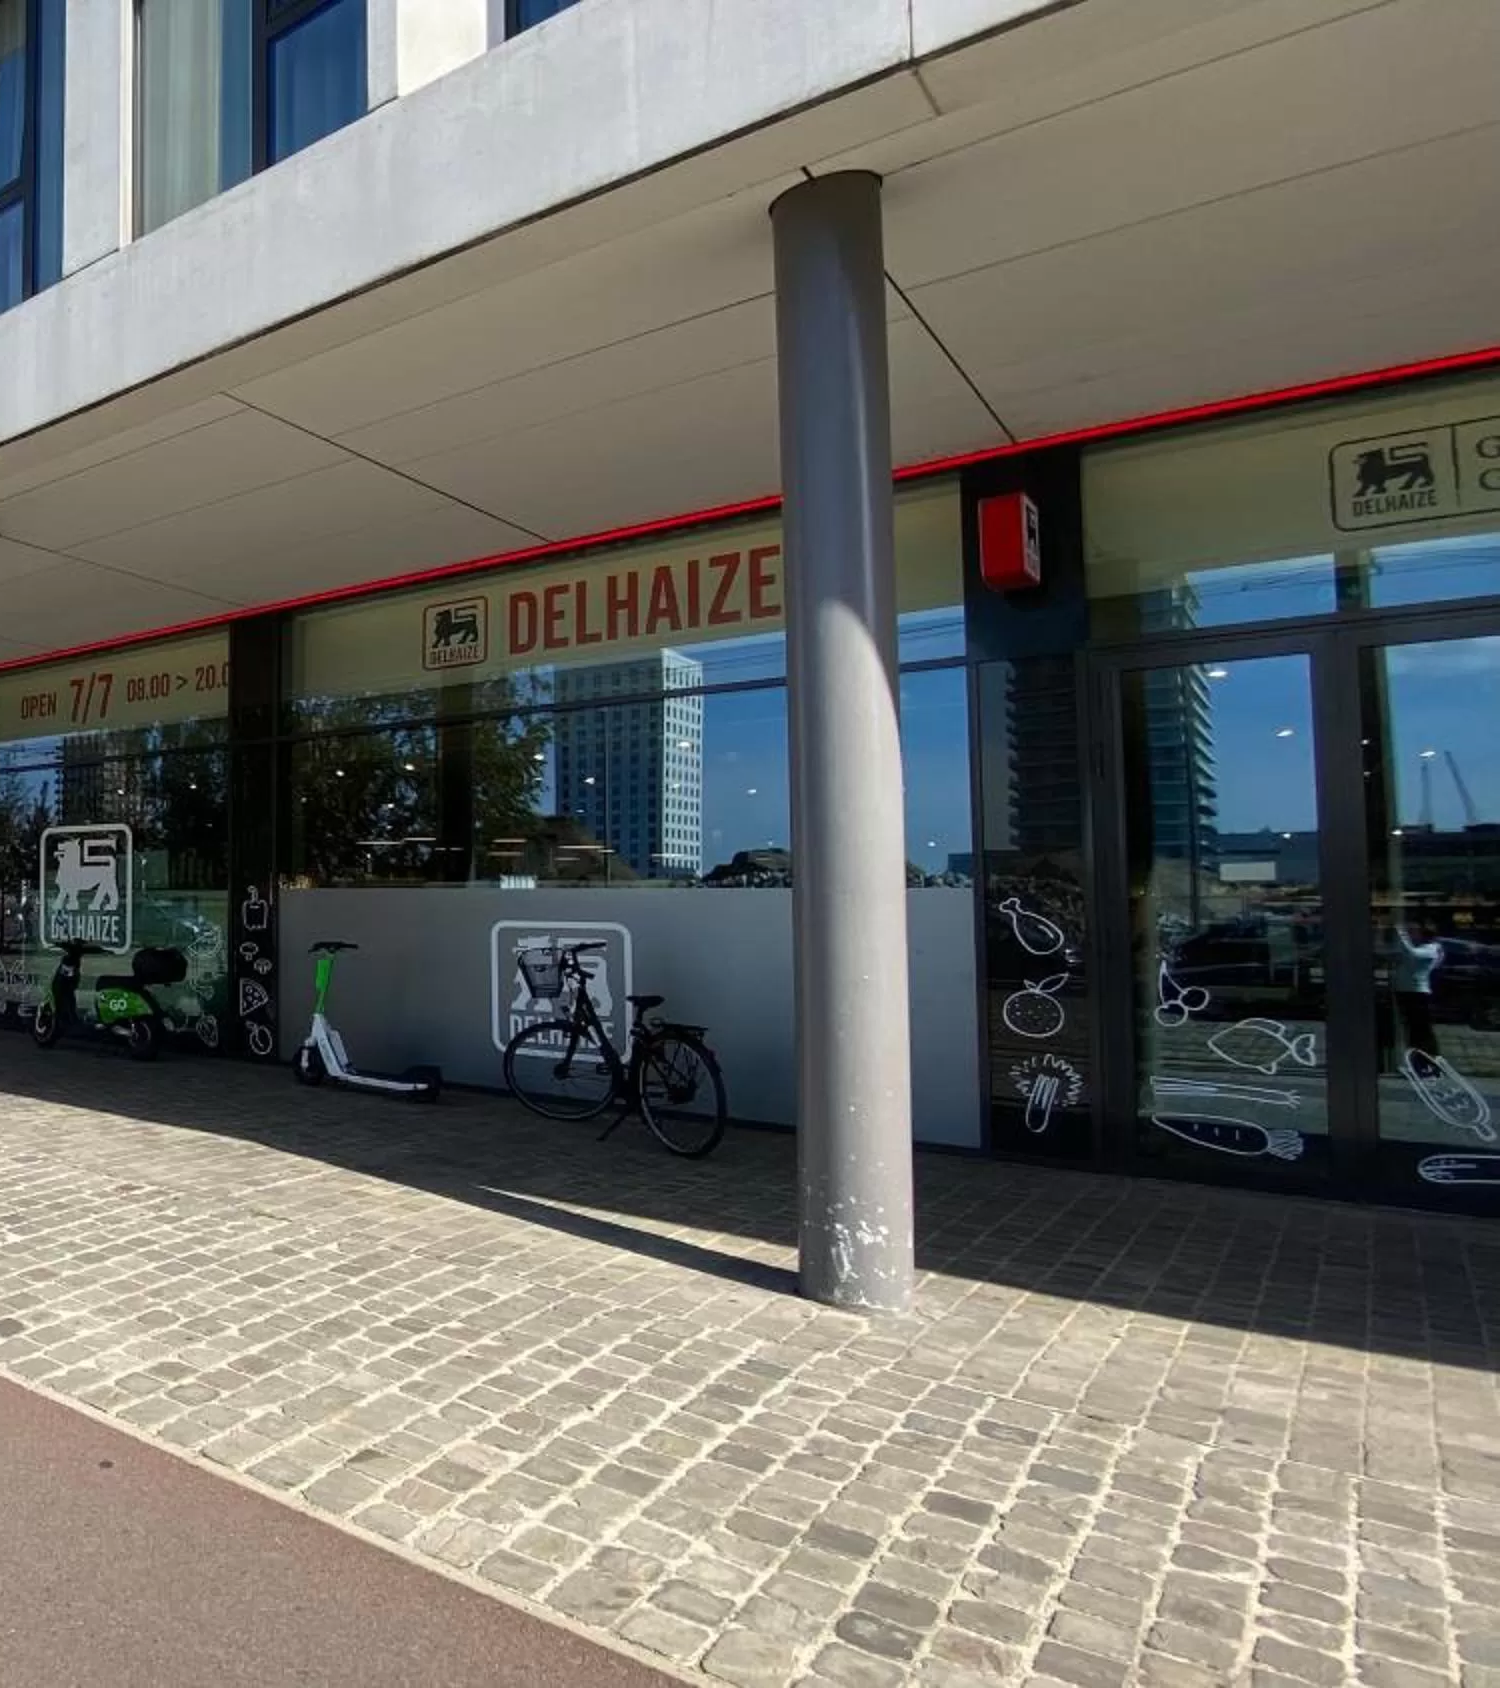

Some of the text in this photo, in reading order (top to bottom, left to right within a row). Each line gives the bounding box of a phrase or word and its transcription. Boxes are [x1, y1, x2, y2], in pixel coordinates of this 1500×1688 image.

[1352, 488, 1438, 518] DELHAIZE
[509, 543, 782, 656] DELHAIZE
[429, 645, 480, 666] DELHAIZE
[20, 691, 57, 720] OPEN
[69, 671, 113, 725] 7/7
[126, 671, 171, 704] 08.00
[50, 915, 120, 943] DELHAIZE
[108, 998, 128, 1012] GO
